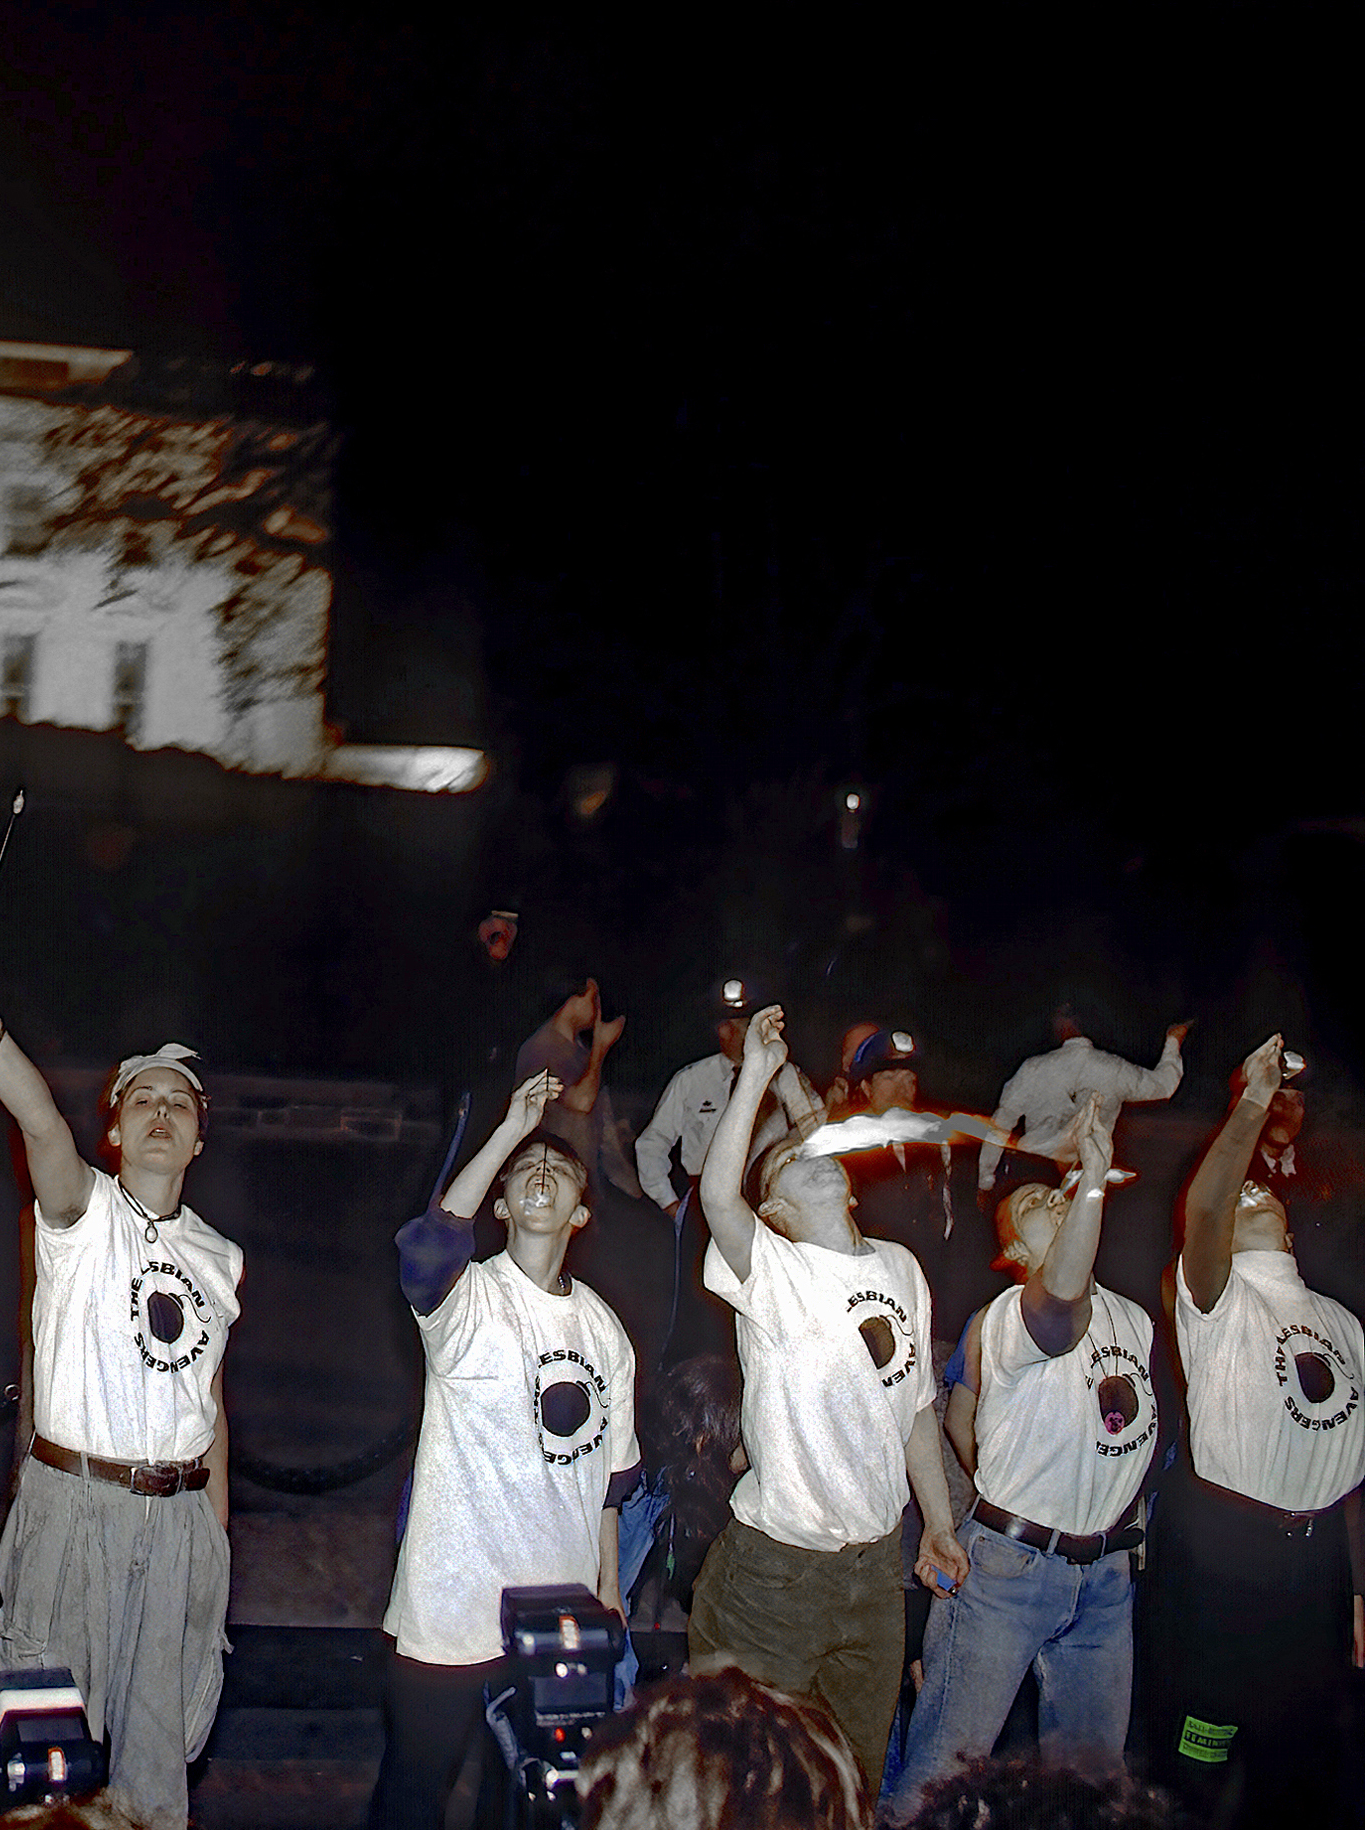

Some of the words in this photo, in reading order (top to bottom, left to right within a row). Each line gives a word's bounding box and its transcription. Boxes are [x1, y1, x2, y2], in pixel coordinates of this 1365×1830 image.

[141, 1261, 205, 1308] LSBIAN
[847, 1290, 907, 1323] ESBIAN
[538, 1349, 607, 1393] ESBIAN
[1284, 1386, 1359, 1431] AVENGERS
